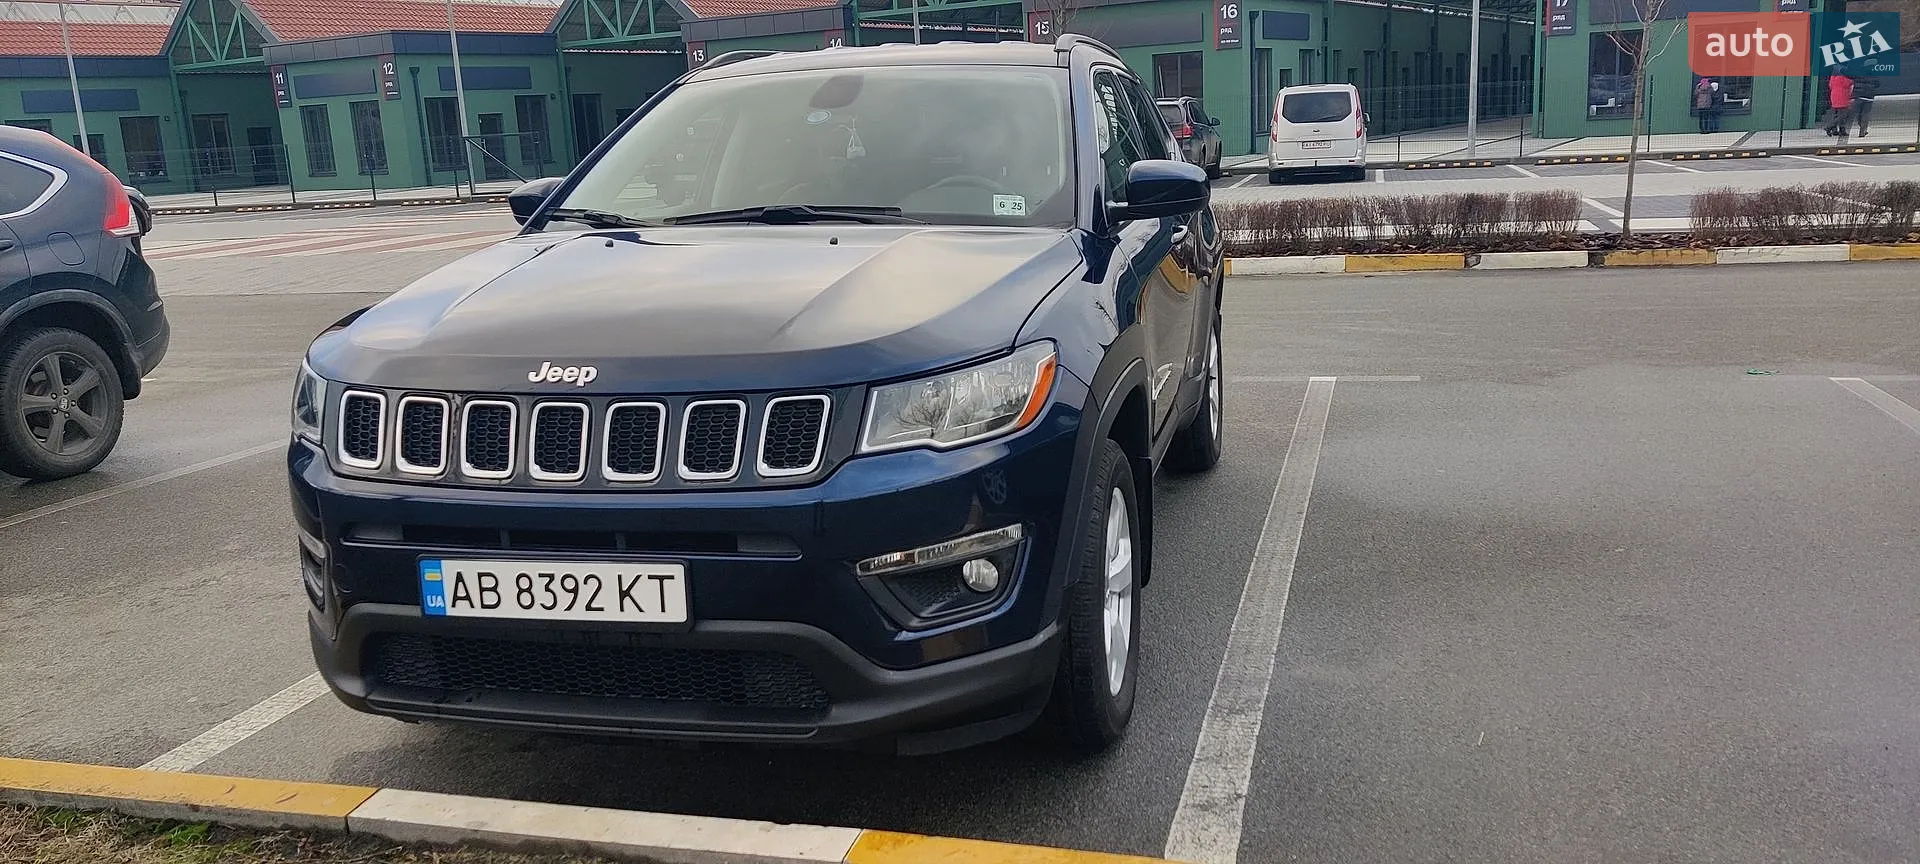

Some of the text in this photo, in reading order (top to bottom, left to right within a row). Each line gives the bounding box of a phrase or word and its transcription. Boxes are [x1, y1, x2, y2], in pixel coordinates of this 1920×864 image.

[1220, 4, 1238, 19] 16
[1035, 20, 1050, 35] 15
[830, 37, 843, 48] 14
[692, 49, 705, 62] 13
[383, 62, 395, 75] 12
[275, 72, 284, 85] 11
[999, 201, 1023, 211] 6 25
[527, 361, 598, 387] Jeep
[451, 571, 676, 613] AB 8392 KT
[426, 595, 446, 608] UA
